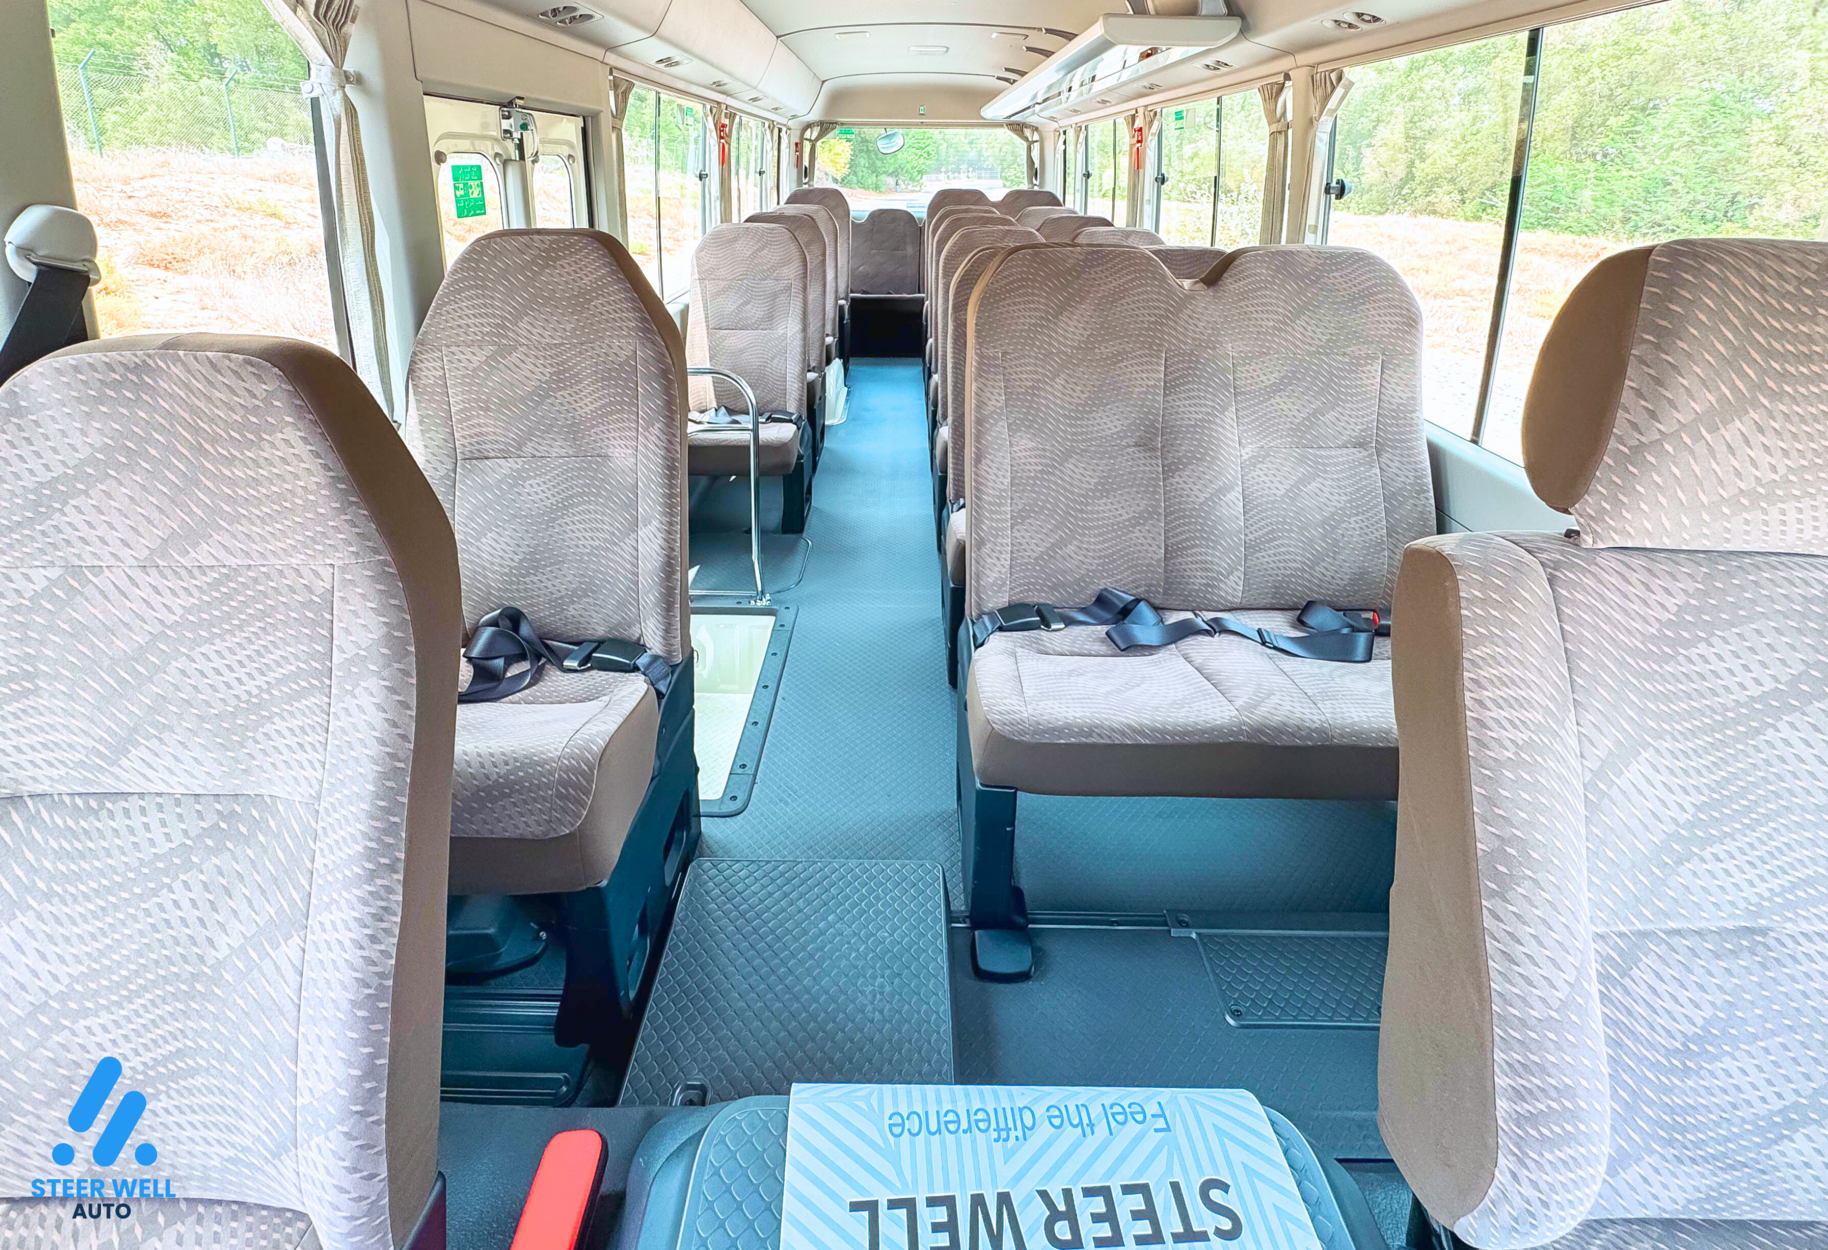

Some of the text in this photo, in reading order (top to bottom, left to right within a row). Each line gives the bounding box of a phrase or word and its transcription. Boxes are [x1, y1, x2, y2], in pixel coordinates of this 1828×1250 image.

[889, 1102, 1172, 1142] Feel the difference
[849, 1178, 1243, 1250] STEER WELL
